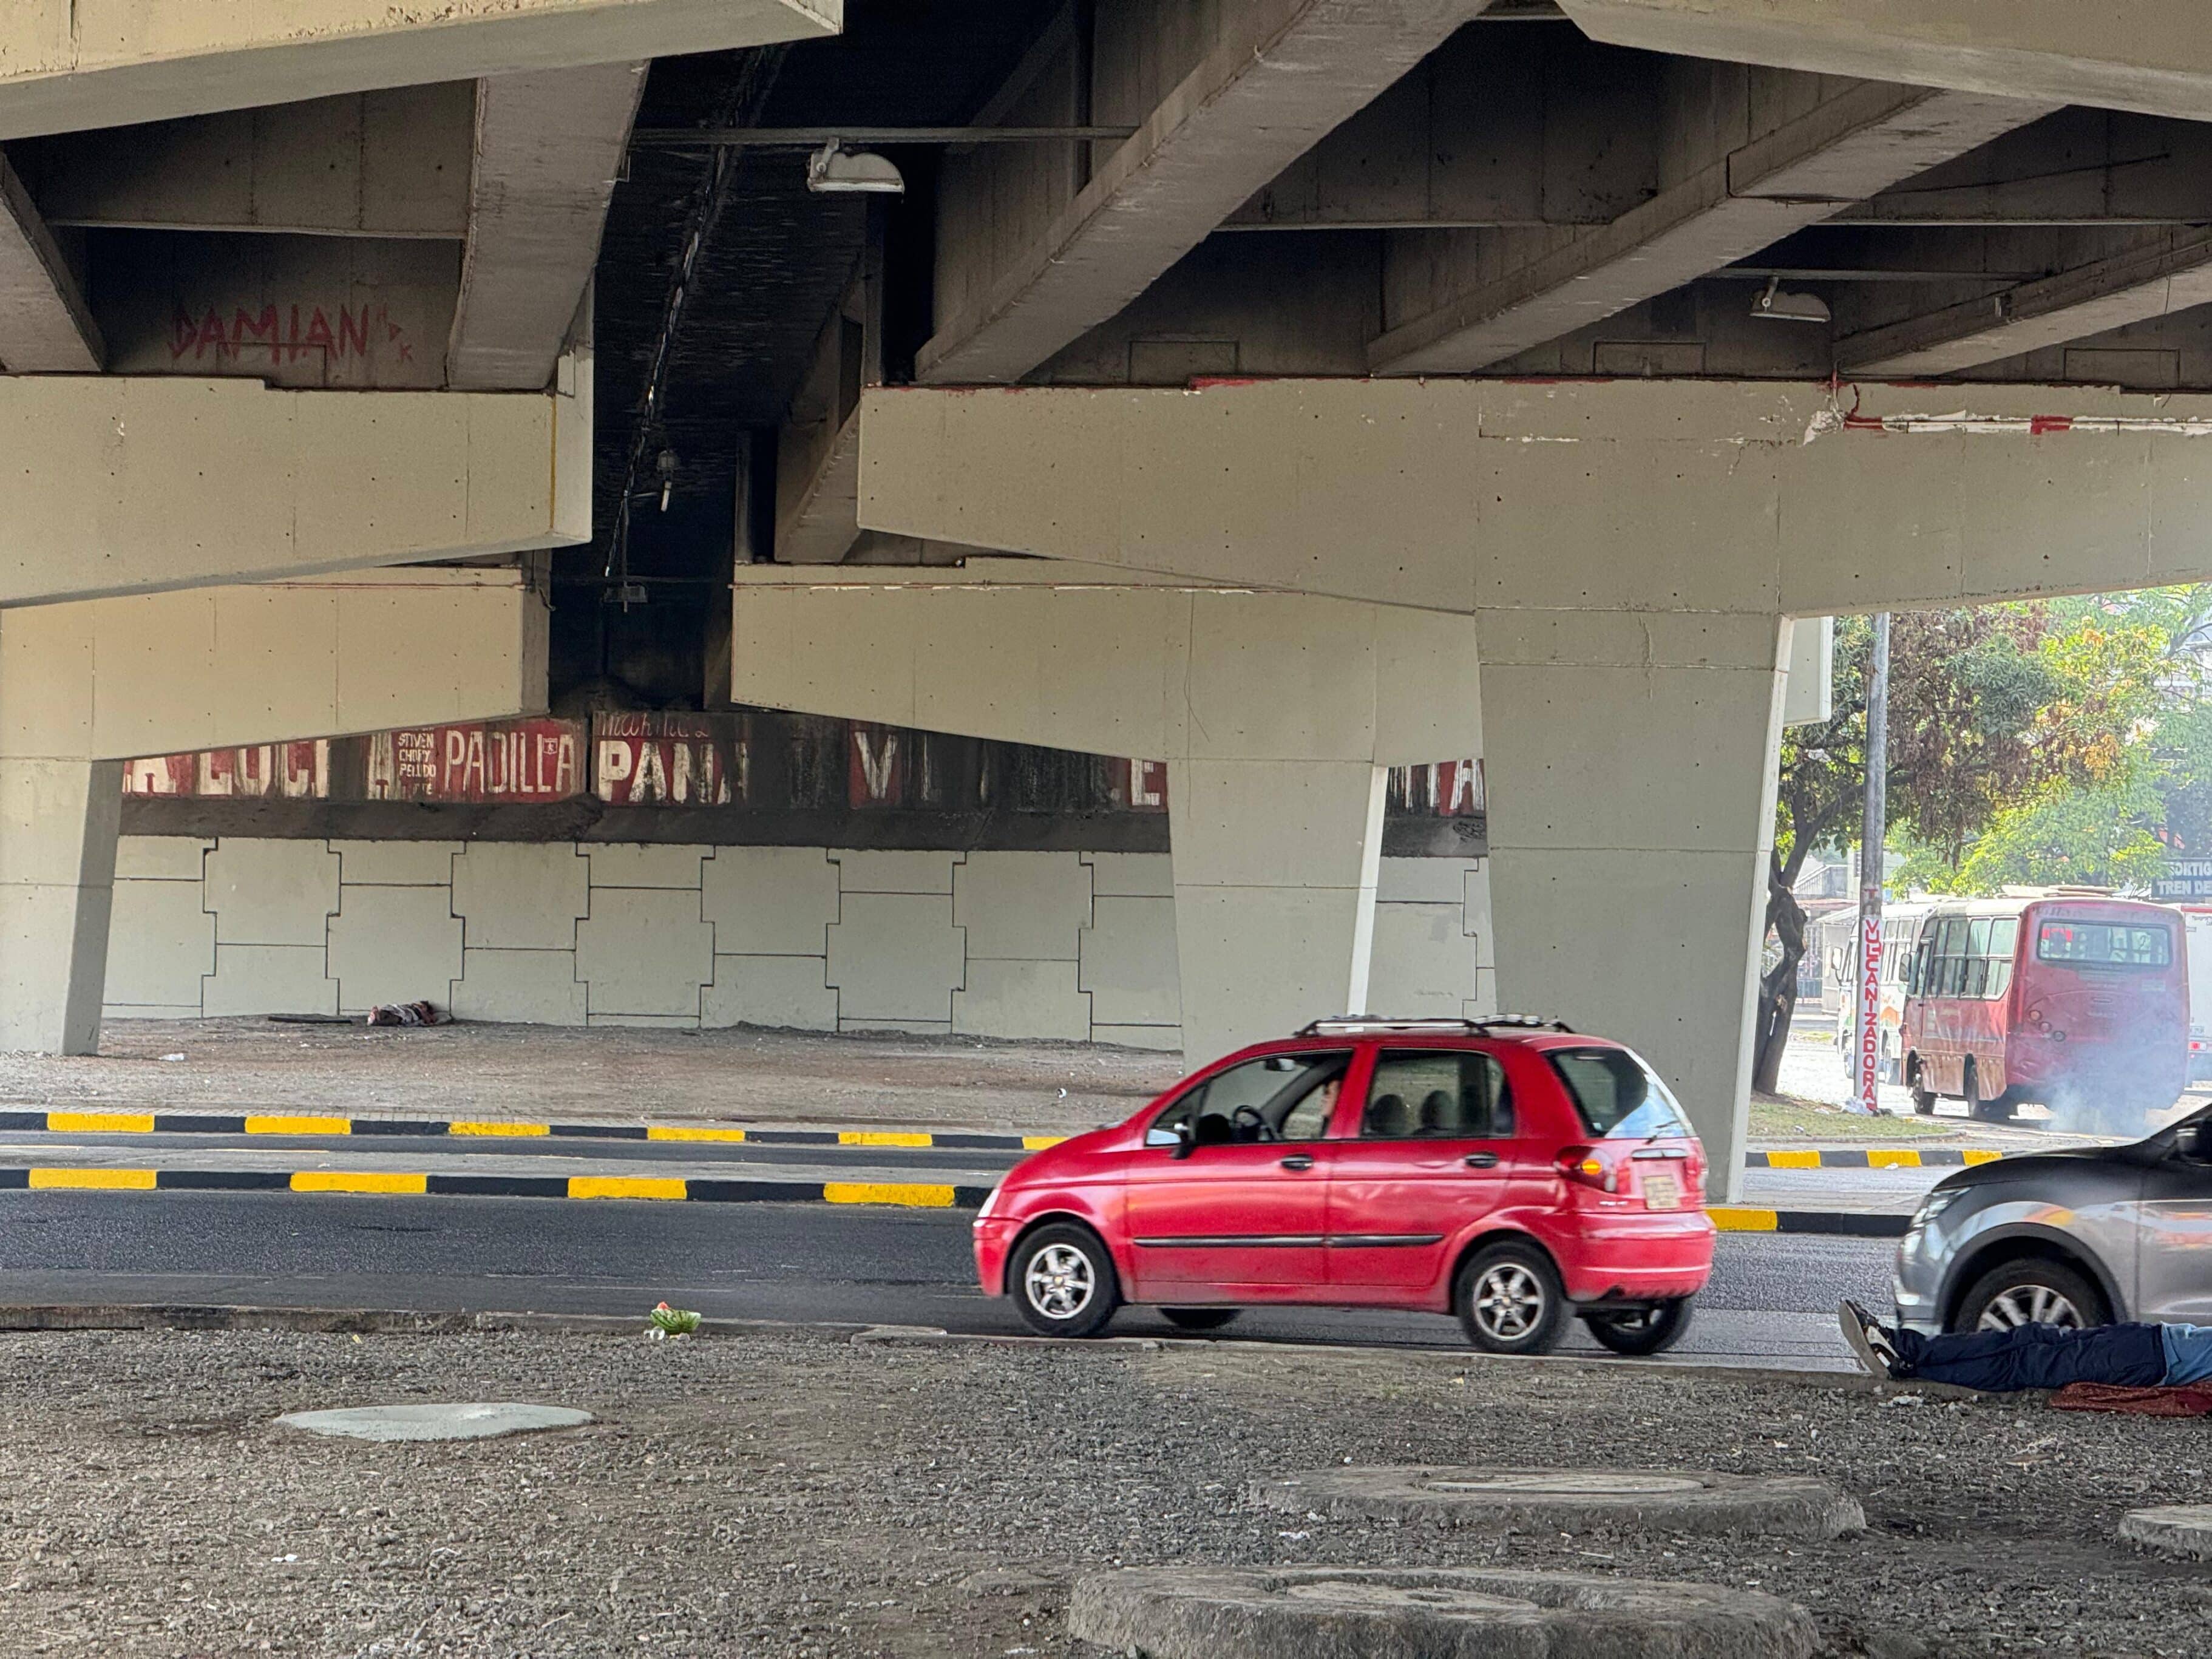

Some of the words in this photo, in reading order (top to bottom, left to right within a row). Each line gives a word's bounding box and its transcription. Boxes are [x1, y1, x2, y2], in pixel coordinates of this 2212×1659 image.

[166, 302, 370, 366] DAMIAN
[445, 728, 575, 794] PADILLA
[2157, 880, 2191, 895] TREN
